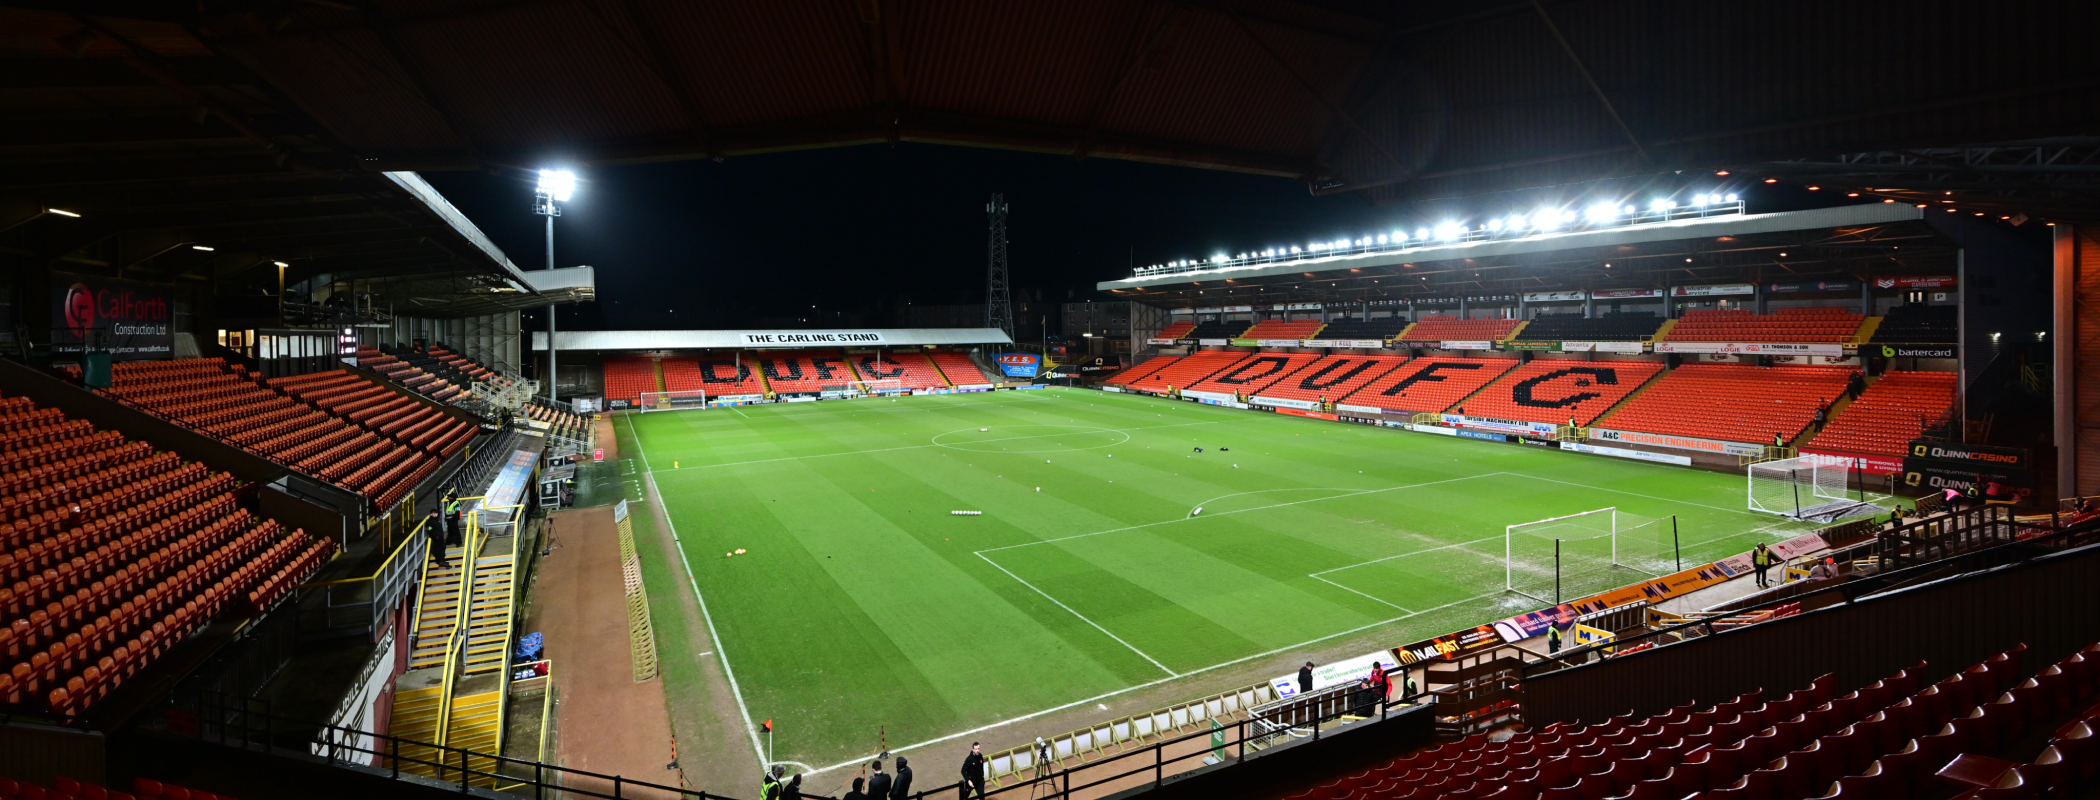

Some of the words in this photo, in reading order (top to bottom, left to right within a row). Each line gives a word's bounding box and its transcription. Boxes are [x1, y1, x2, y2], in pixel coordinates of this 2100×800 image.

[98, 288, 166, 320] CalForth
[114, 323, 155, 335] Construction
[156, 324, 166, 335] Ltd
[746, 334, 775, 343] THE
[778, 334, 836, 342] CARLING
[1898, 348, 1951, 356] bartercard
[1486, 417, 1518, 425] MACHINERY
[1602, 431, 1619, 440] A&C
[1620, 432, 1663, 445] PRECISION
[1665, 437, 1724, 451] ENGINEERING
[1931, 447, 2018, 463] QUINNCASINO
[1413, 640, 1460, 660] NAILFAST
